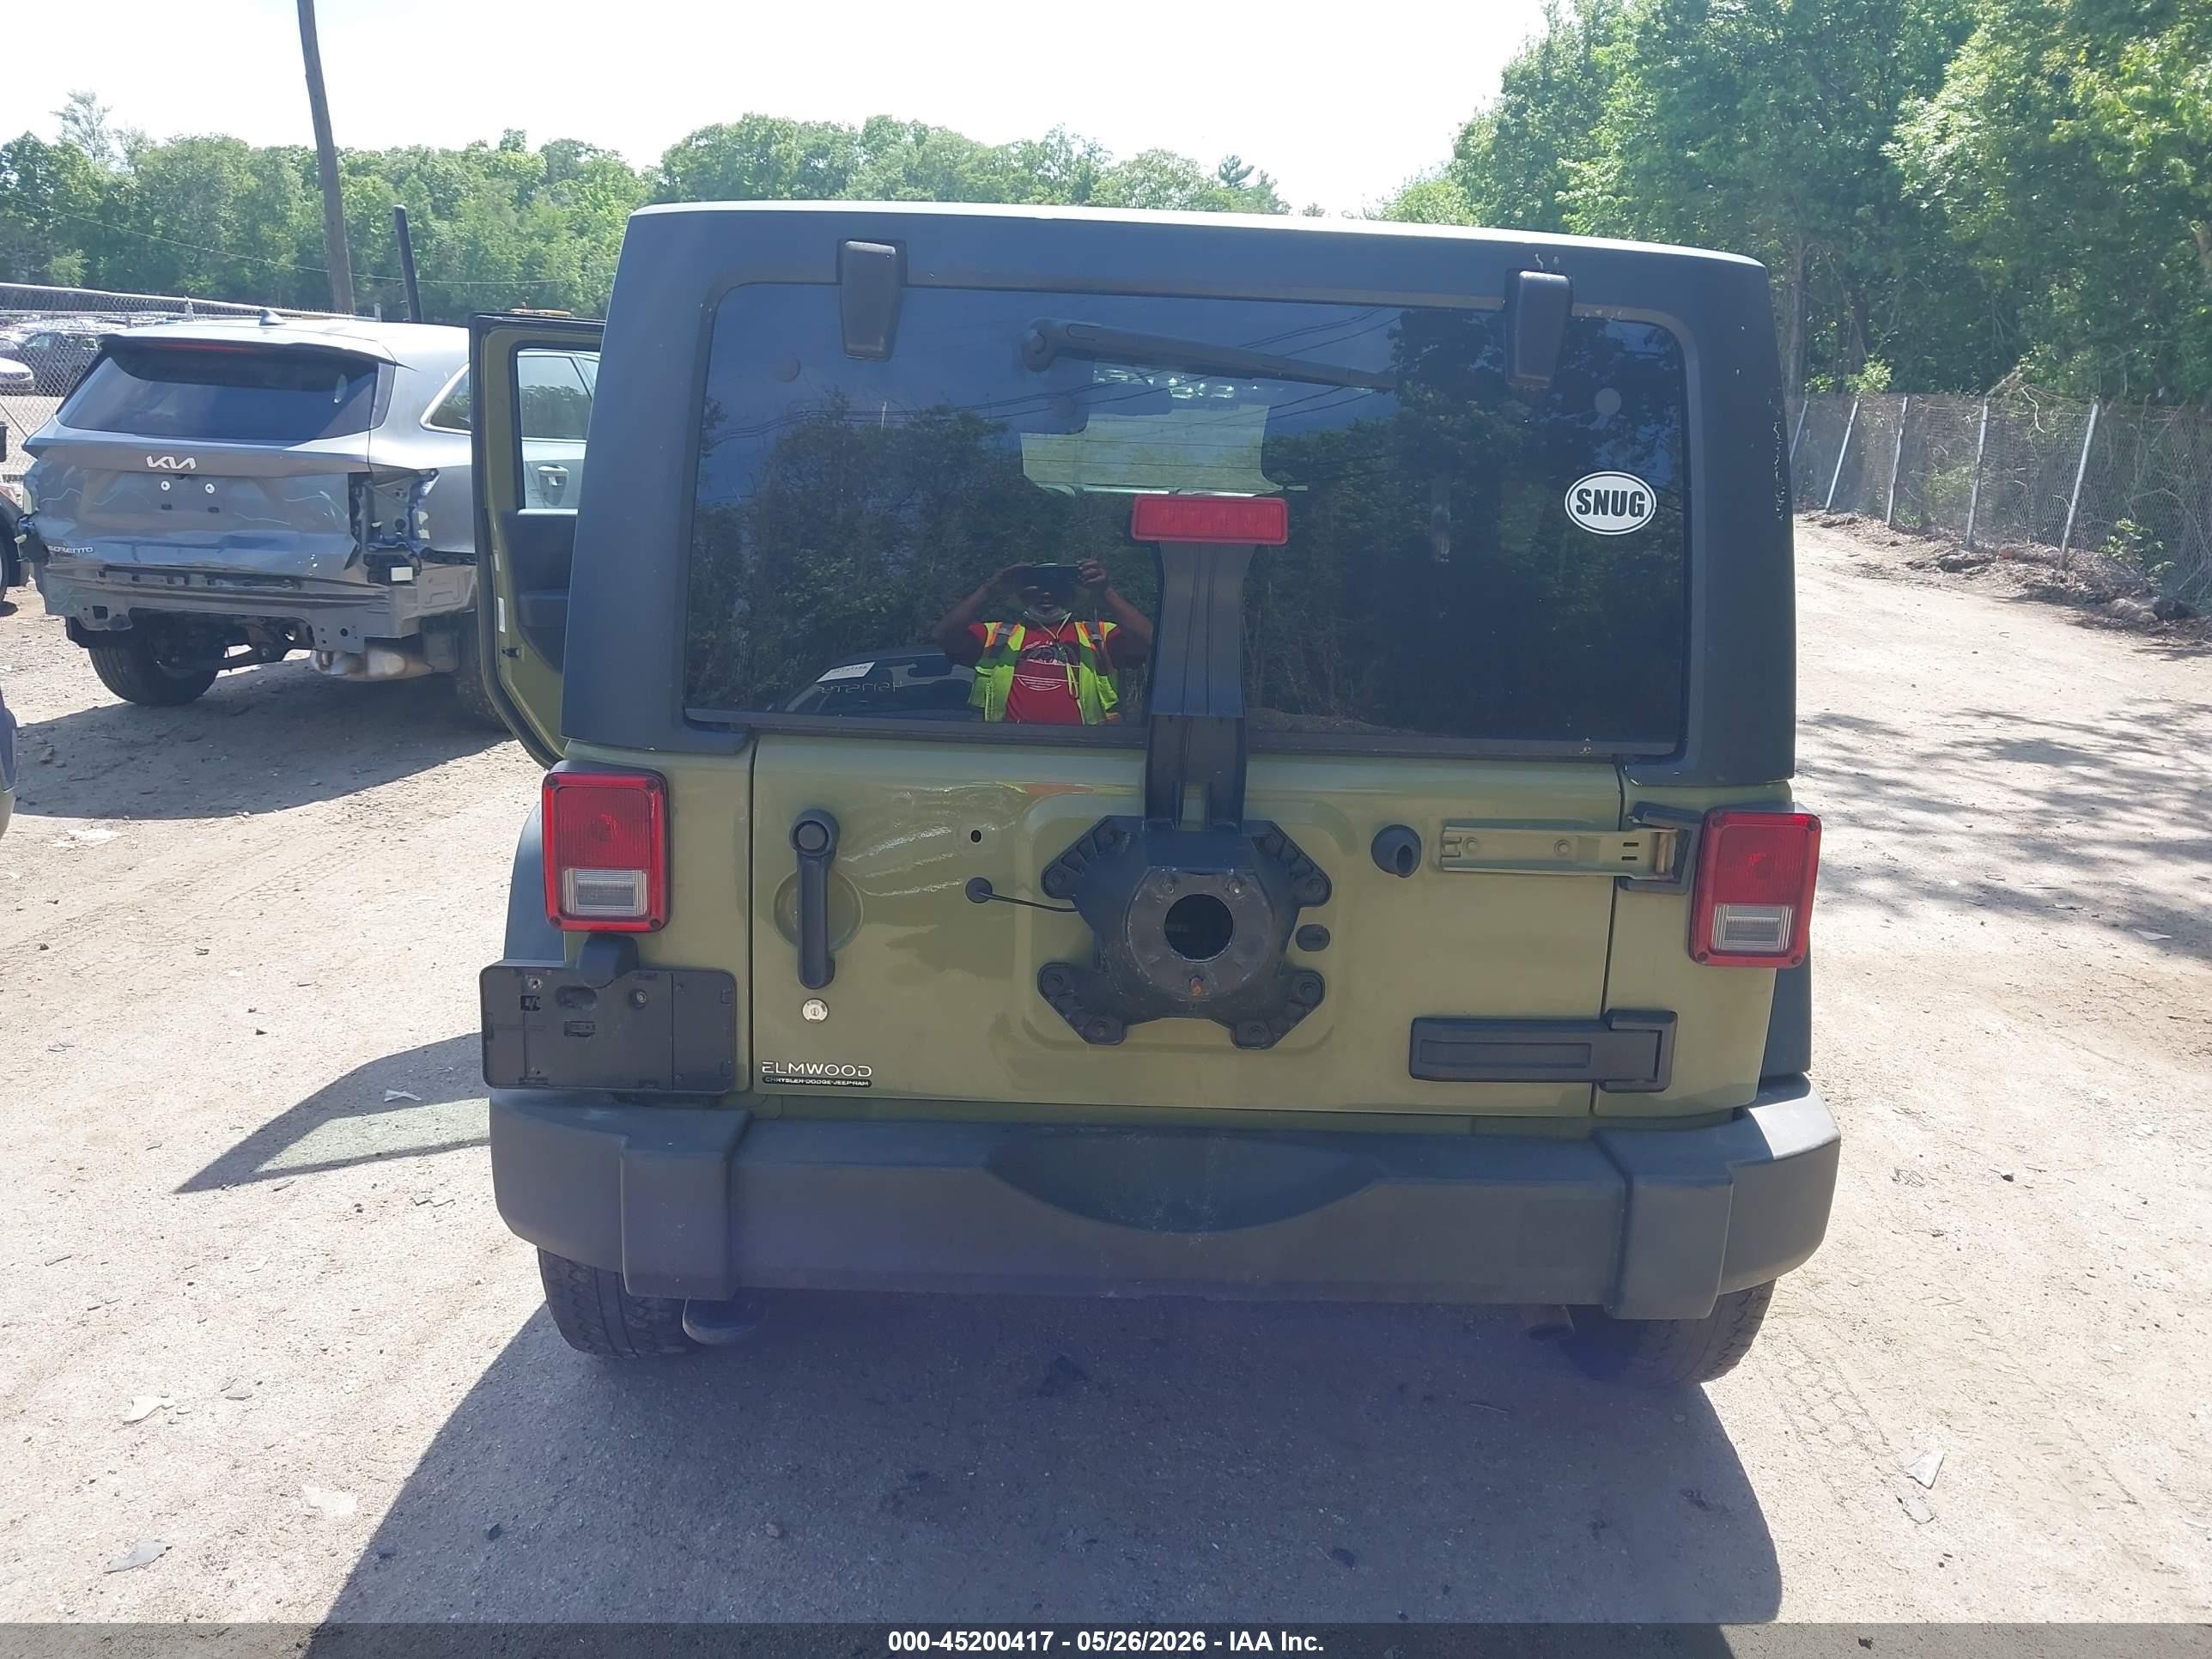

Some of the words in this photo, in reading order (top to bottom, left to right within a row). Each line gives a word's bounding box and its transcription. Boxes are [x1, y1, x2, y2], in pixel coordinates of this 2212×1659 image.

[146, 455, 197, 470] KIA
[1576, 489, 1645, 518] SNUG
[762, 1061, 872, 1077] ELMWOOD
